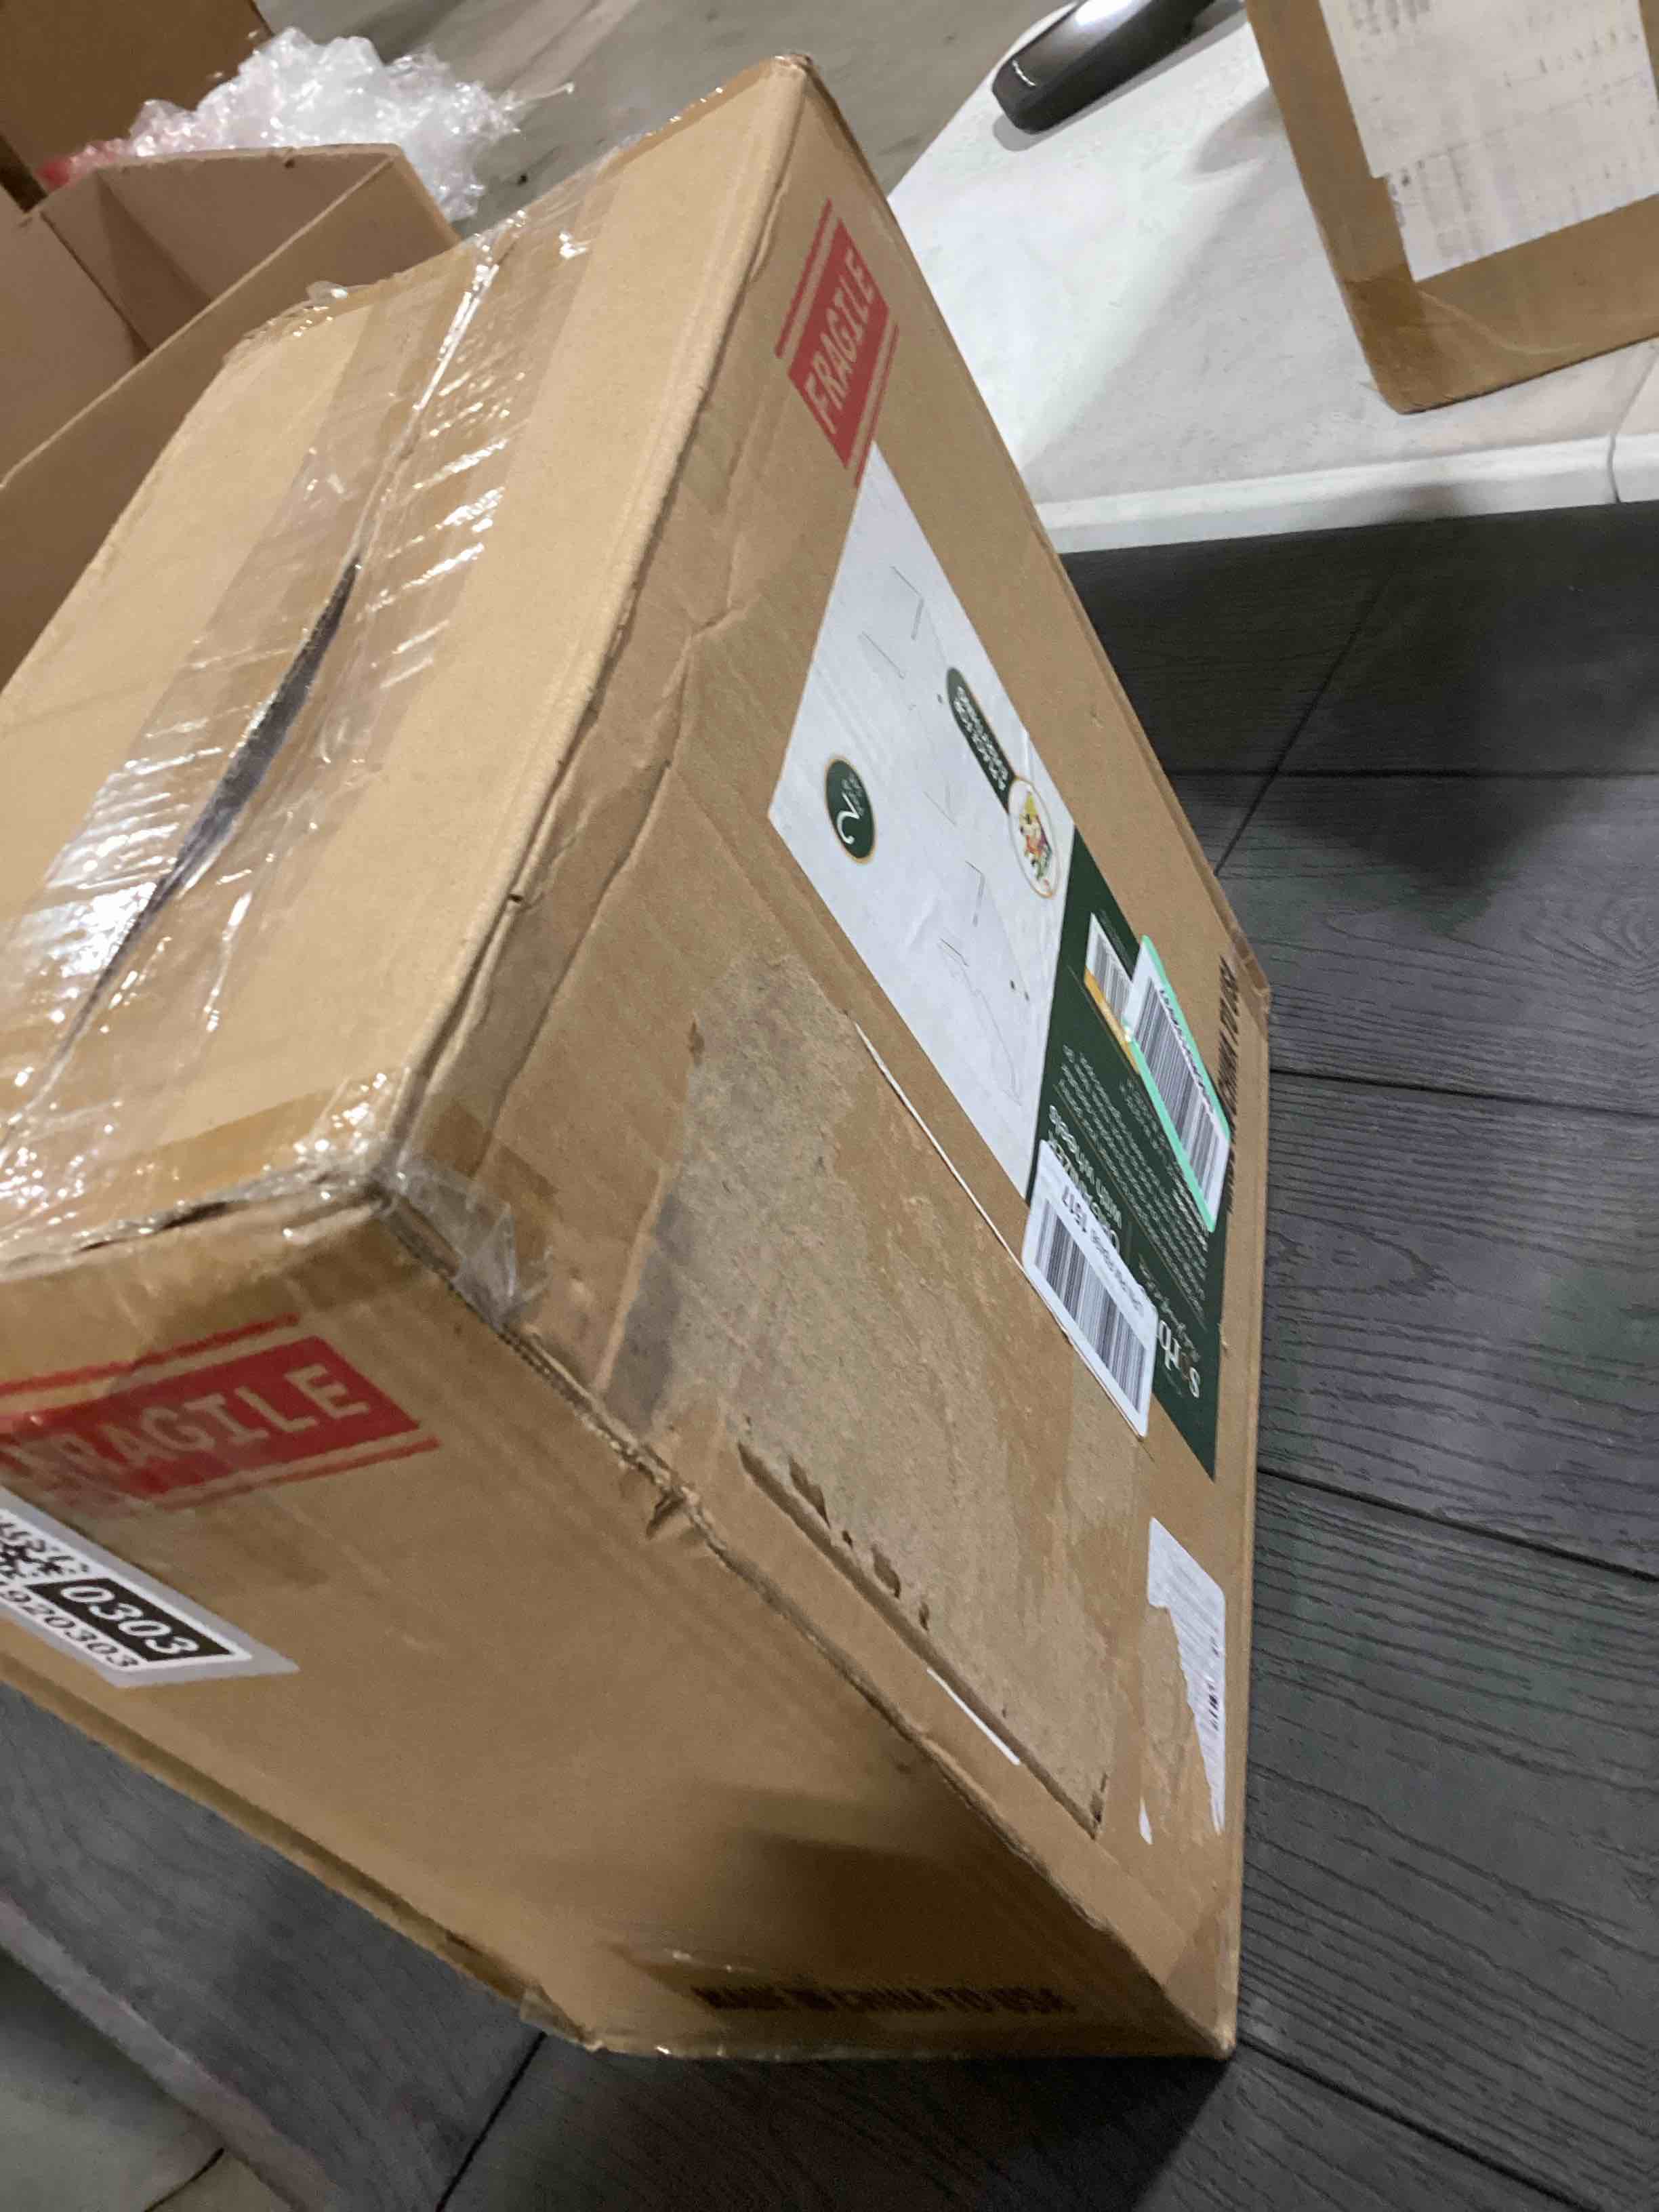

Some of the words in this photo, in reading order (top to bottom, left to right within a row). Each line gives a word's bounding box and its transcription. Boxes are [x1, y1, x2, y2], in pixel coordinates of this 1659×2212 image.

[804, 248, 876, 435] FRAGILE
[0, 1579, 140, 1667] 920303
[60, 1585, 199, 1654] 0303
